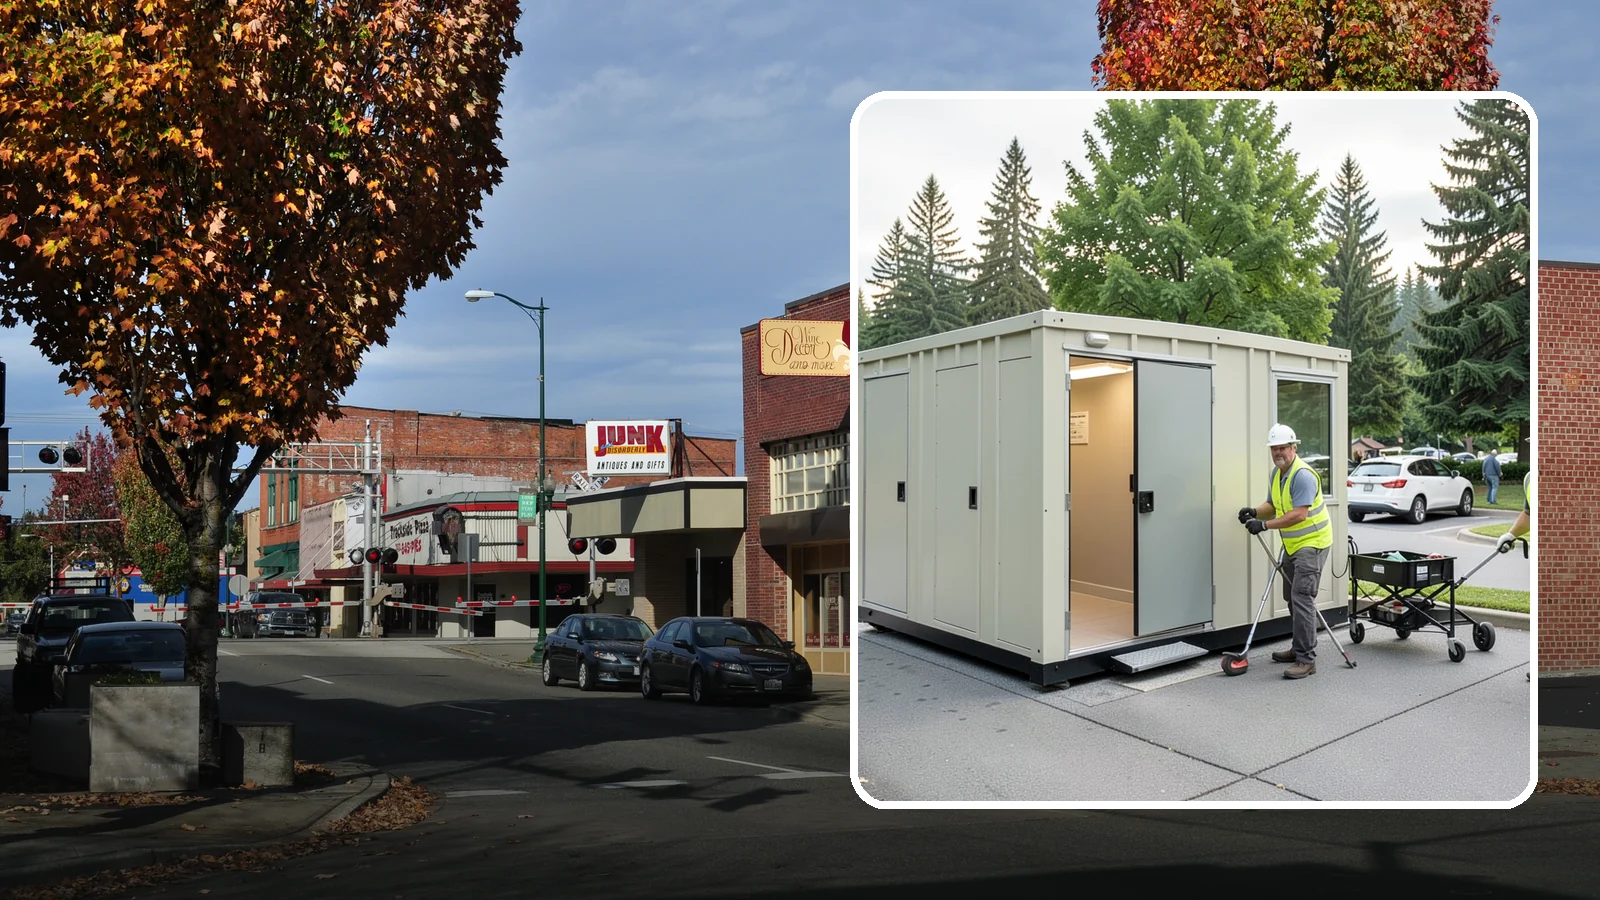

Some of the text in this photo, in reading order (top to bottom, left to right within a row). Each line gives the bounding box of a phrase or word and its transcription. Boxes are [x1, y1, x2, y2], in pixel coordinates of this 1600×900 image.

[596, 425, 664, 457] JUNK
[596, 460, 665, 470] ANTIQUES AND GIFTS
[414, 519, 429, 535] Pizza
